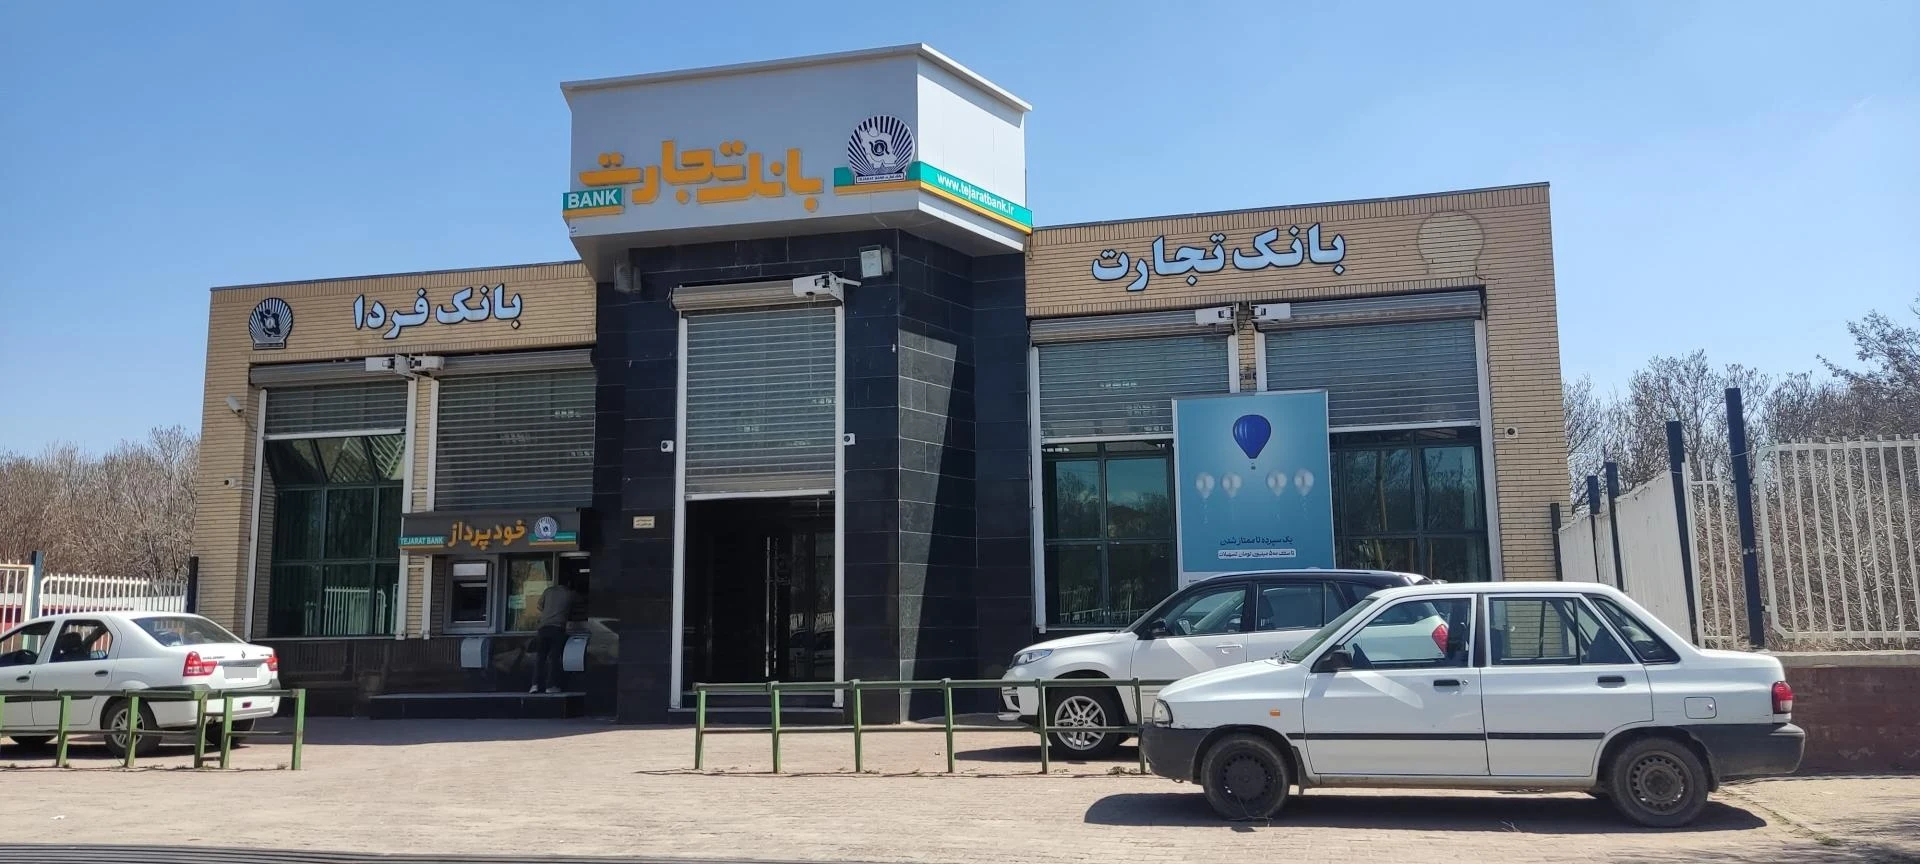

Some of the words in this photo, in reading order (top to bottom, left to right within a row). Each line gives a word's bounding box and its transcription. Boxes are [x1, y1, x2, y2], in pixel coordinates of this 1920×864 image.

[579, 140, 746, 205] تجارت
[696, 148, 823, 212] بانک
[937, 174, 1015, 216] www.tejaratbank.ir
[568, 189, 618, 209] BANK
[1092, 231, 1227, 292] تجارت
[1233, 222, 1346, 275] بانک
[353, 287, 430, 339] فردا
[435, 283, 523, 330] بانک
[400, 536, 426, 545] TEJARAT
[427, 536, 444, 544] BANK
[1282, 536, 1293, 545] یک
